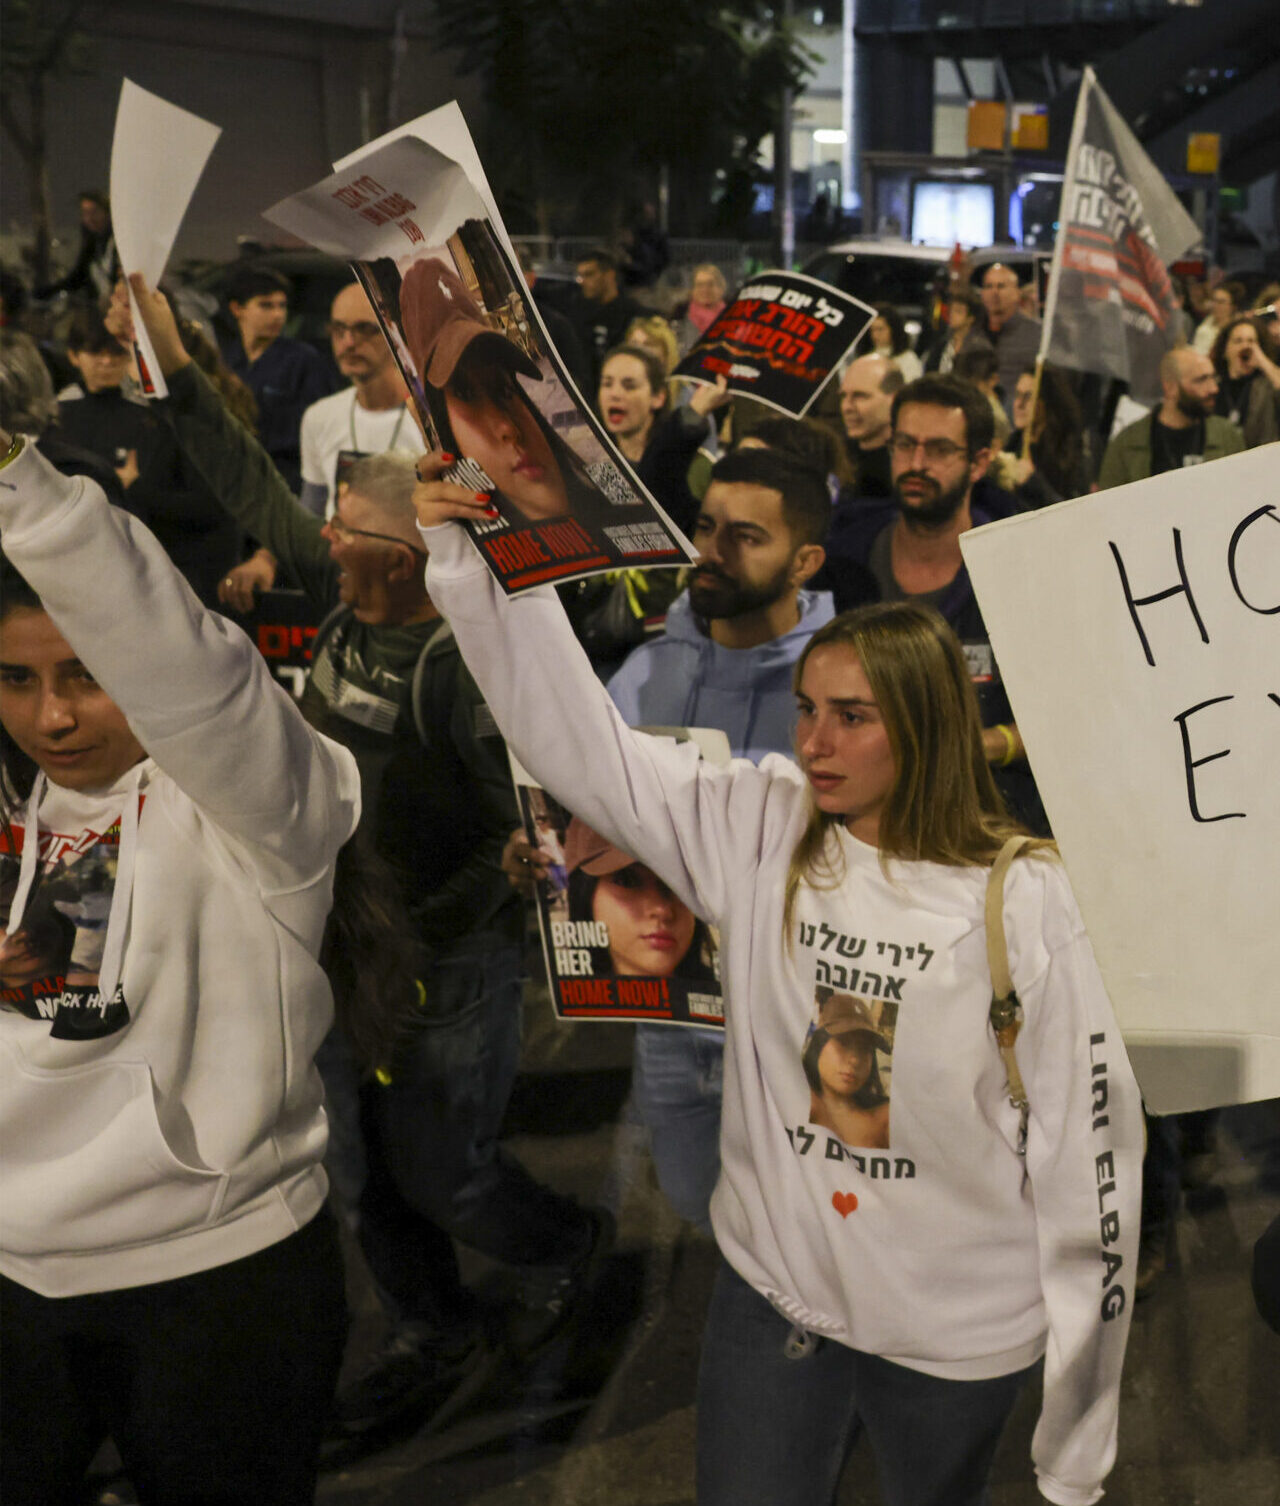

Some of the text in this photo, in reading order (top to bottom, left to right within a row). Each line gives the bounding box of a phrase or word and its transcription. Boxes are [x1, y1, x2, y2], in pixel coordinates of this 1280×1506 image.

[779, 288, 814, 311] יום
[813, 297, 845, 328] כל
[758, 302, 826, 342] הורג
[484, 529, 550, 575] HOME
[535, 516, 601, 559] NOW!
[550, 920, 610, 949] BRING
[800, 921, 935, 972] לירי שלנו
[554, 949, 595, 977] HER
[815, 958, 908, 1002] אהובה
[559, 979, 615, 1006] HOME
[616, 977, 671, 1009] NOW!
[1088, 1032, 1126, 1323] LIRI ELBAG
